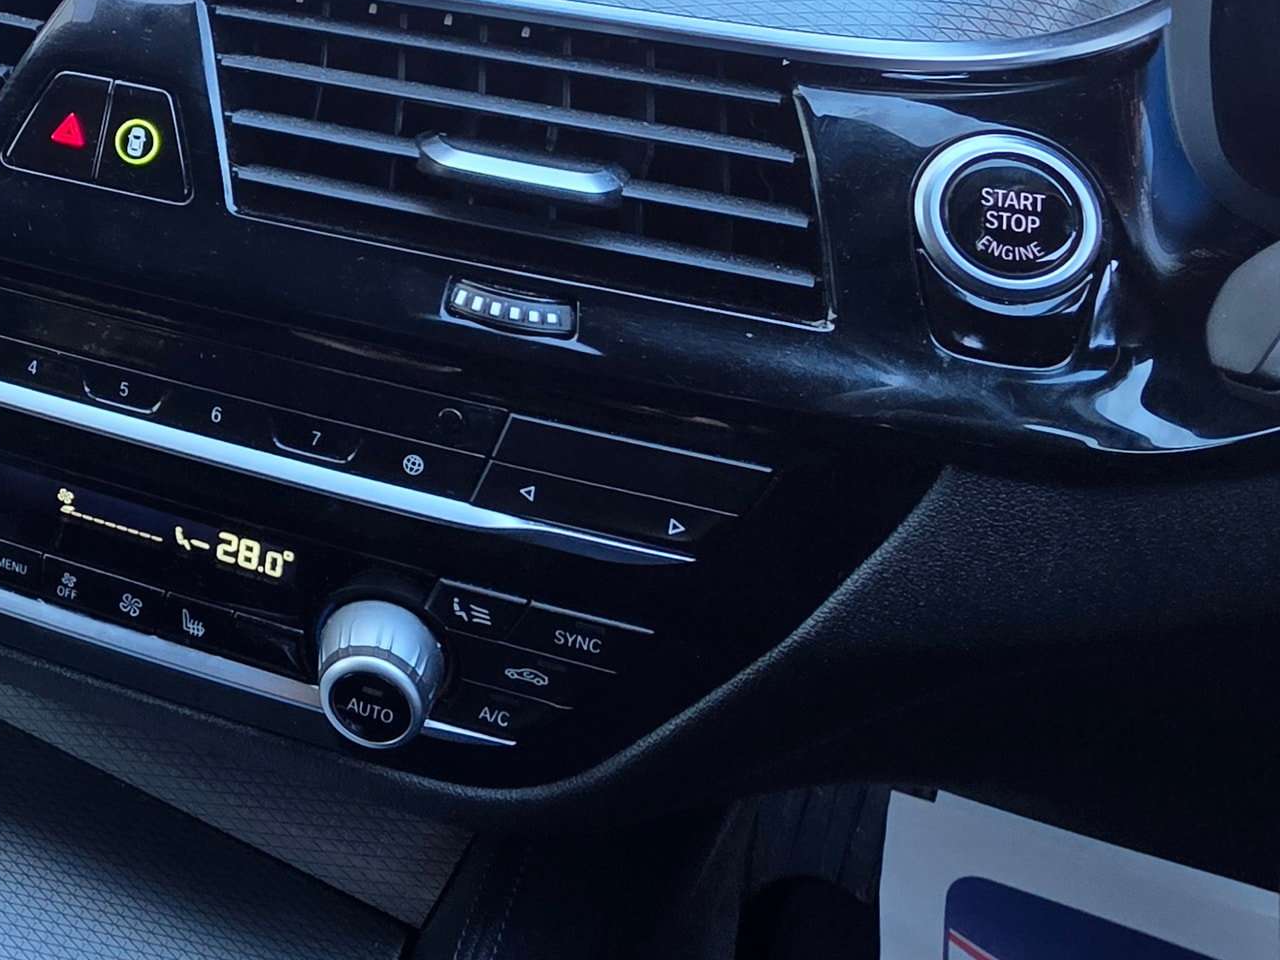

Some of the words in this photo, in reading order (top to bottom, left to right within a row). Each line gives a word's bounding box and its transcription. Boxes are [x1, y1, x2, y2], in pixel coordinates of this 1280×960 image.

[980, 188, 1046, 212] START
[985, 211, 1041, 233] STOP
[976, 235, 1045, 261] ENGINE
[27, 360, 38, 375] 4
[119, 382, 129, 397] 5
[211, 407, 222, 423] 6
[311, 431, 321, 445] 7
[56, 586, 77, 600] OFF
[553, 629, 603, 654] SYNC
[346, 697, 394, 725] AUTO
[478, 705, 510, 727] A/C
